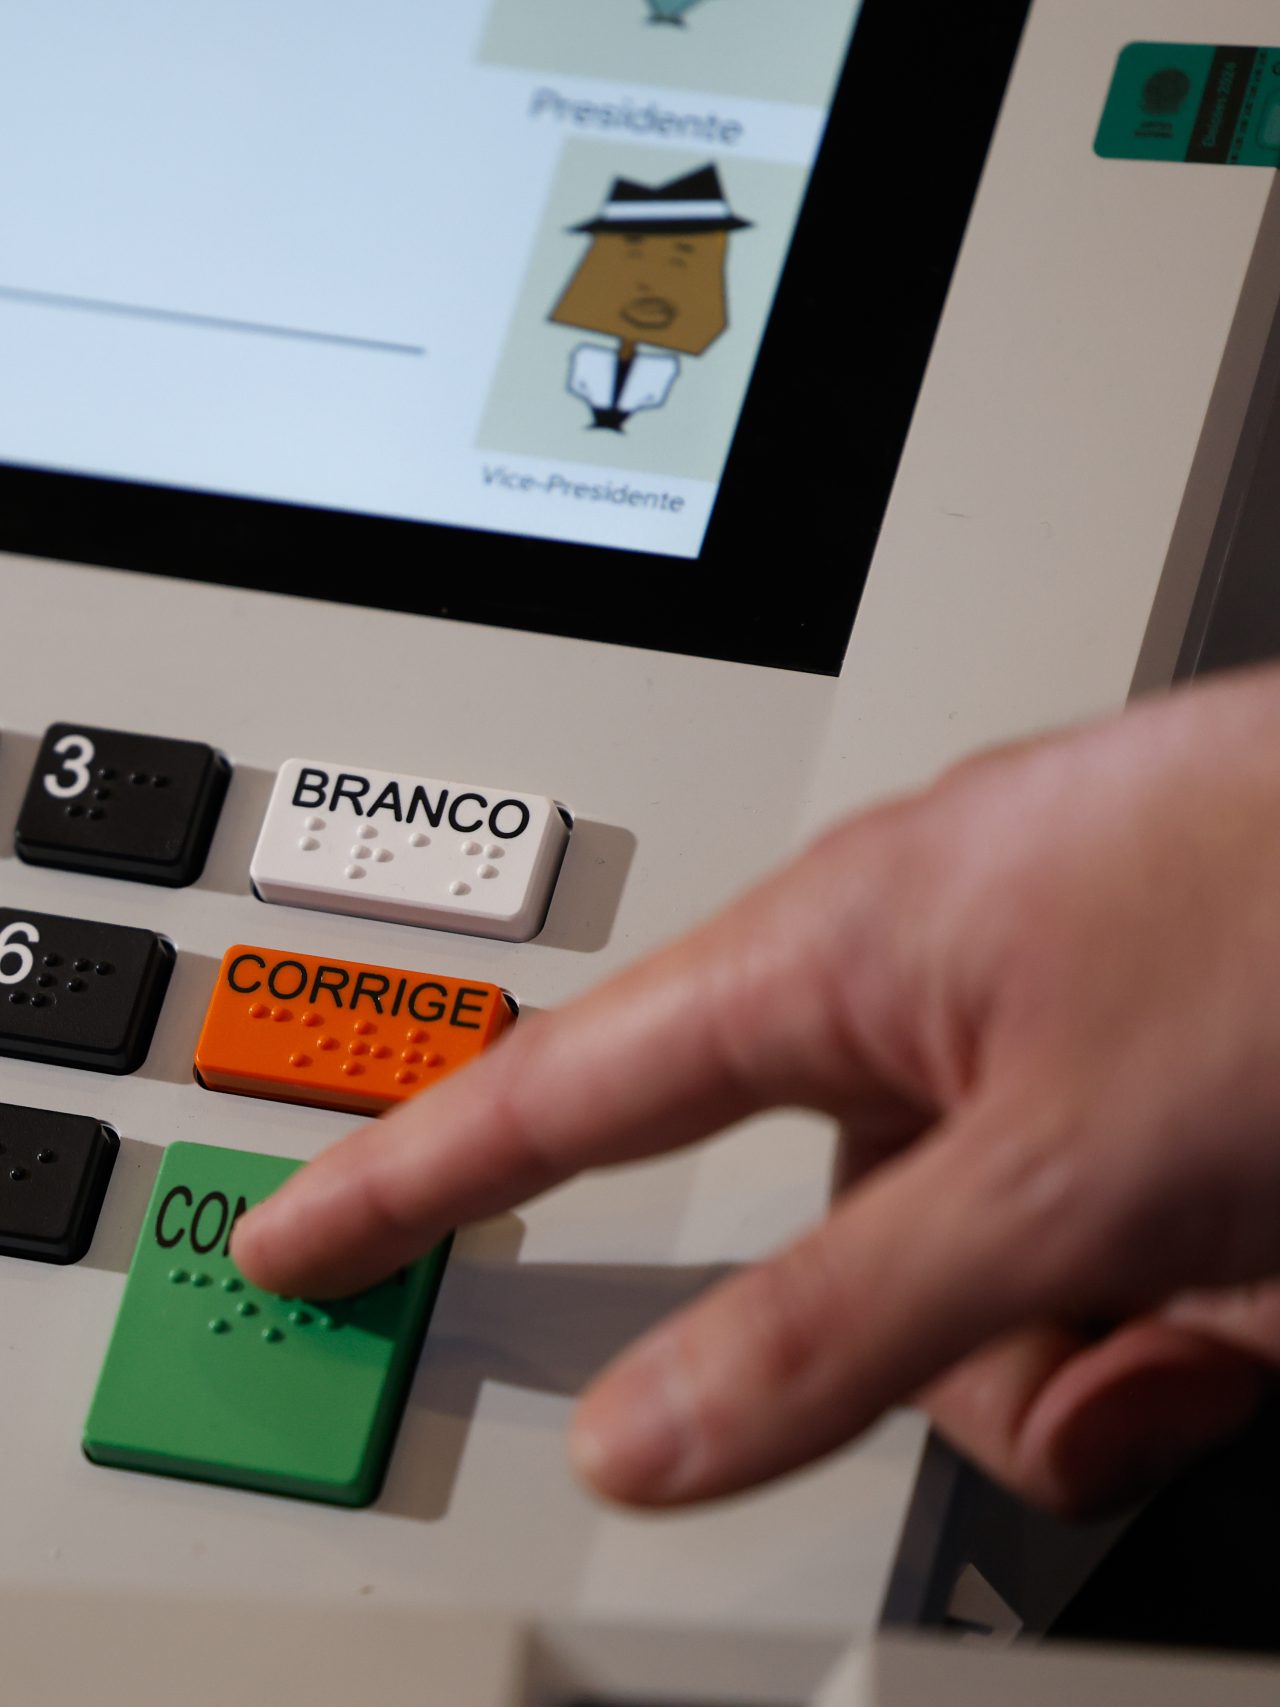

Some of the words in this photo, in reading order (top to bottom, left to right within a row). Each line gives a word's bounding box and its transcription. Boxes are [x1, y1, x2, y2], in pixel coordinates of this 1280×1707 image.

[527, 86, 743, 146] Presidente
[481, 463, 685, 512] Vice-Presidente
[43, 734, 95, 799] 3
[291, 767, 530, 840] BRANCO
[227, 954, 490, 1031] CORRIGE
